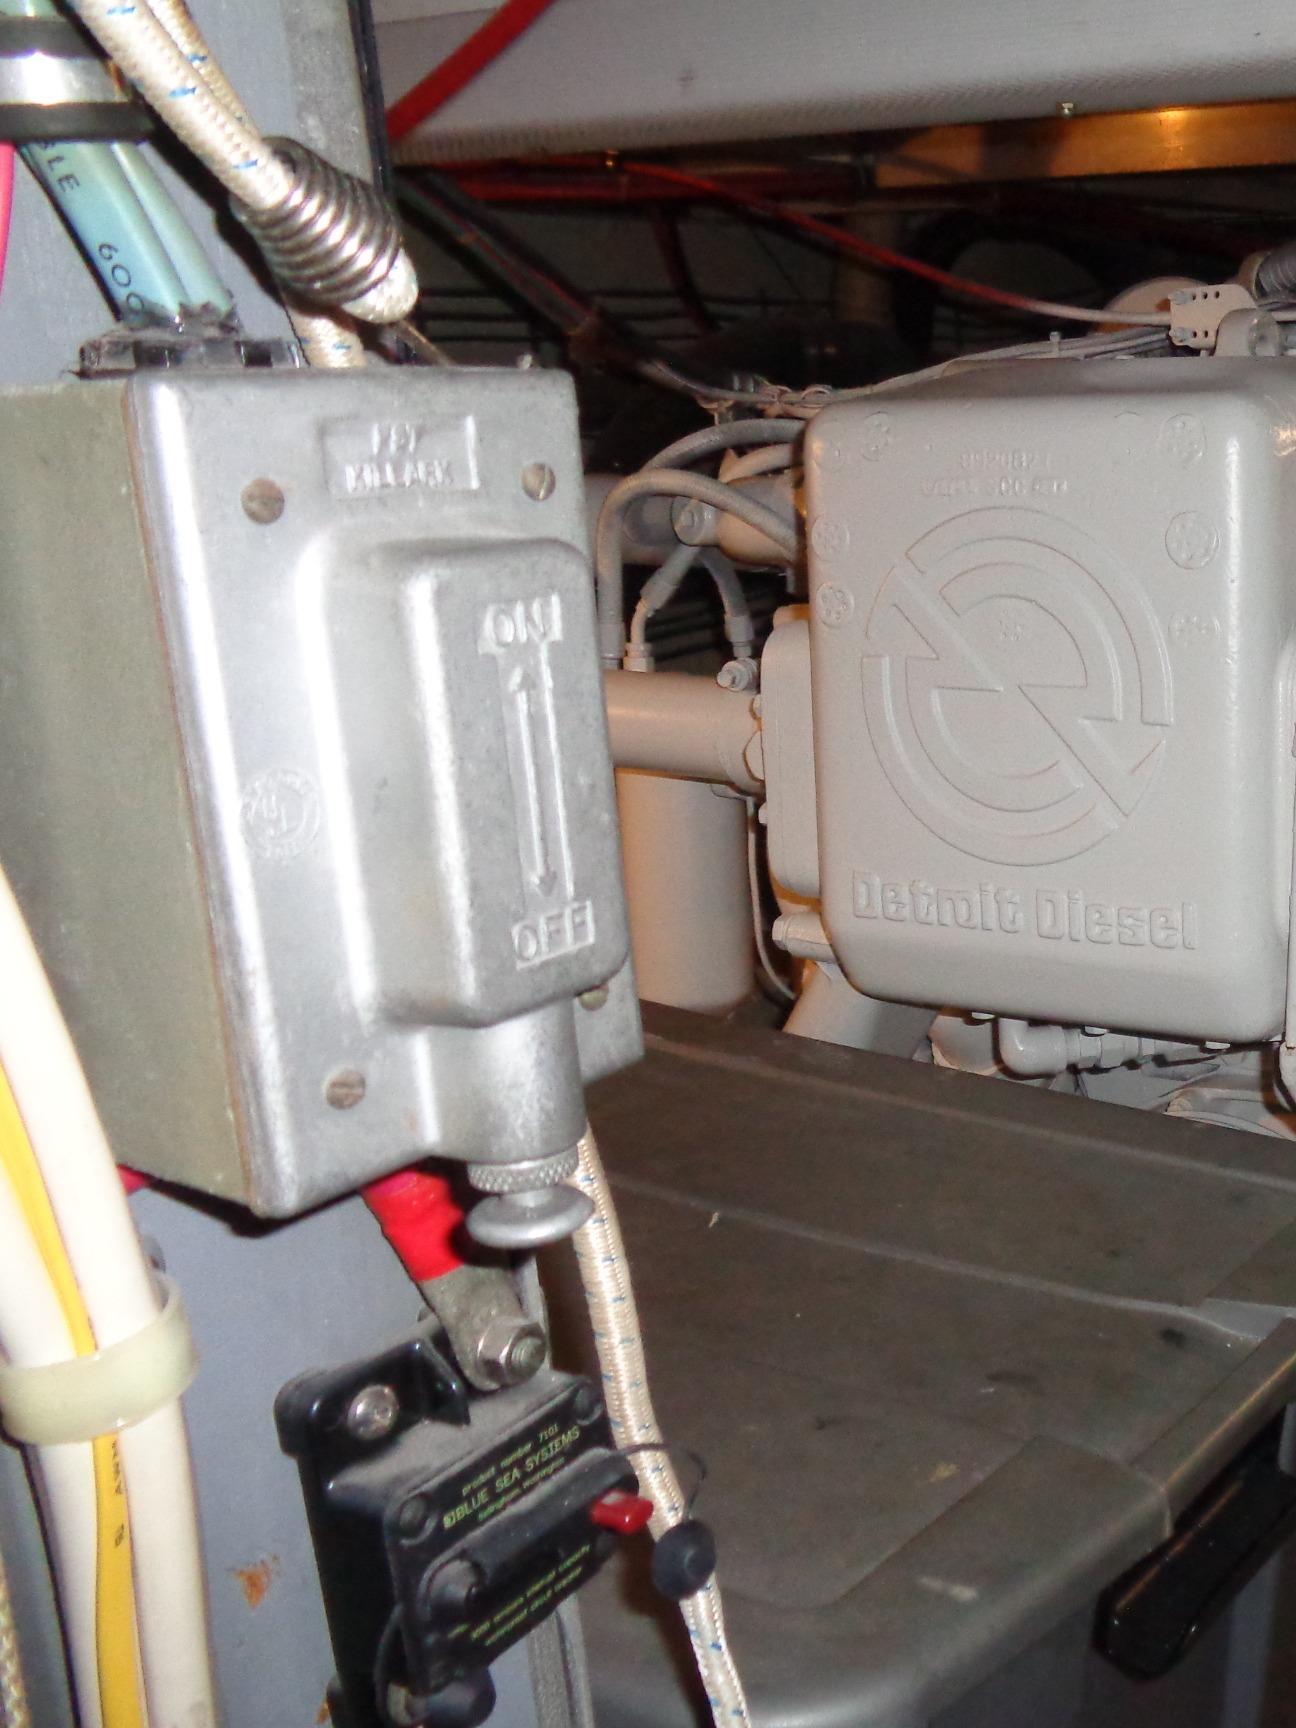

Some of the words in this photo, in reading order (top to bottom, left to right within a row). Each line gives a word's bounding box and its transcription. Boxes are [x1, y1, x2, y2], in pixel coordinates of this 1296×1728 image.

[43, 141, 80, 193] LE
[98, 243, 144, 316] 600
[491, 597, 550, 648] ON
[513, 903, 588, 960] OFF
[853, 871, 1027, 935] Detroit
[1035, 887, 1198, 951] Diesel
[454, 1487, 490, 1521] BLUE
[495, 1467, 522, 1493] SEA
[525, 1424, 581, 1472] SYSTEMS
